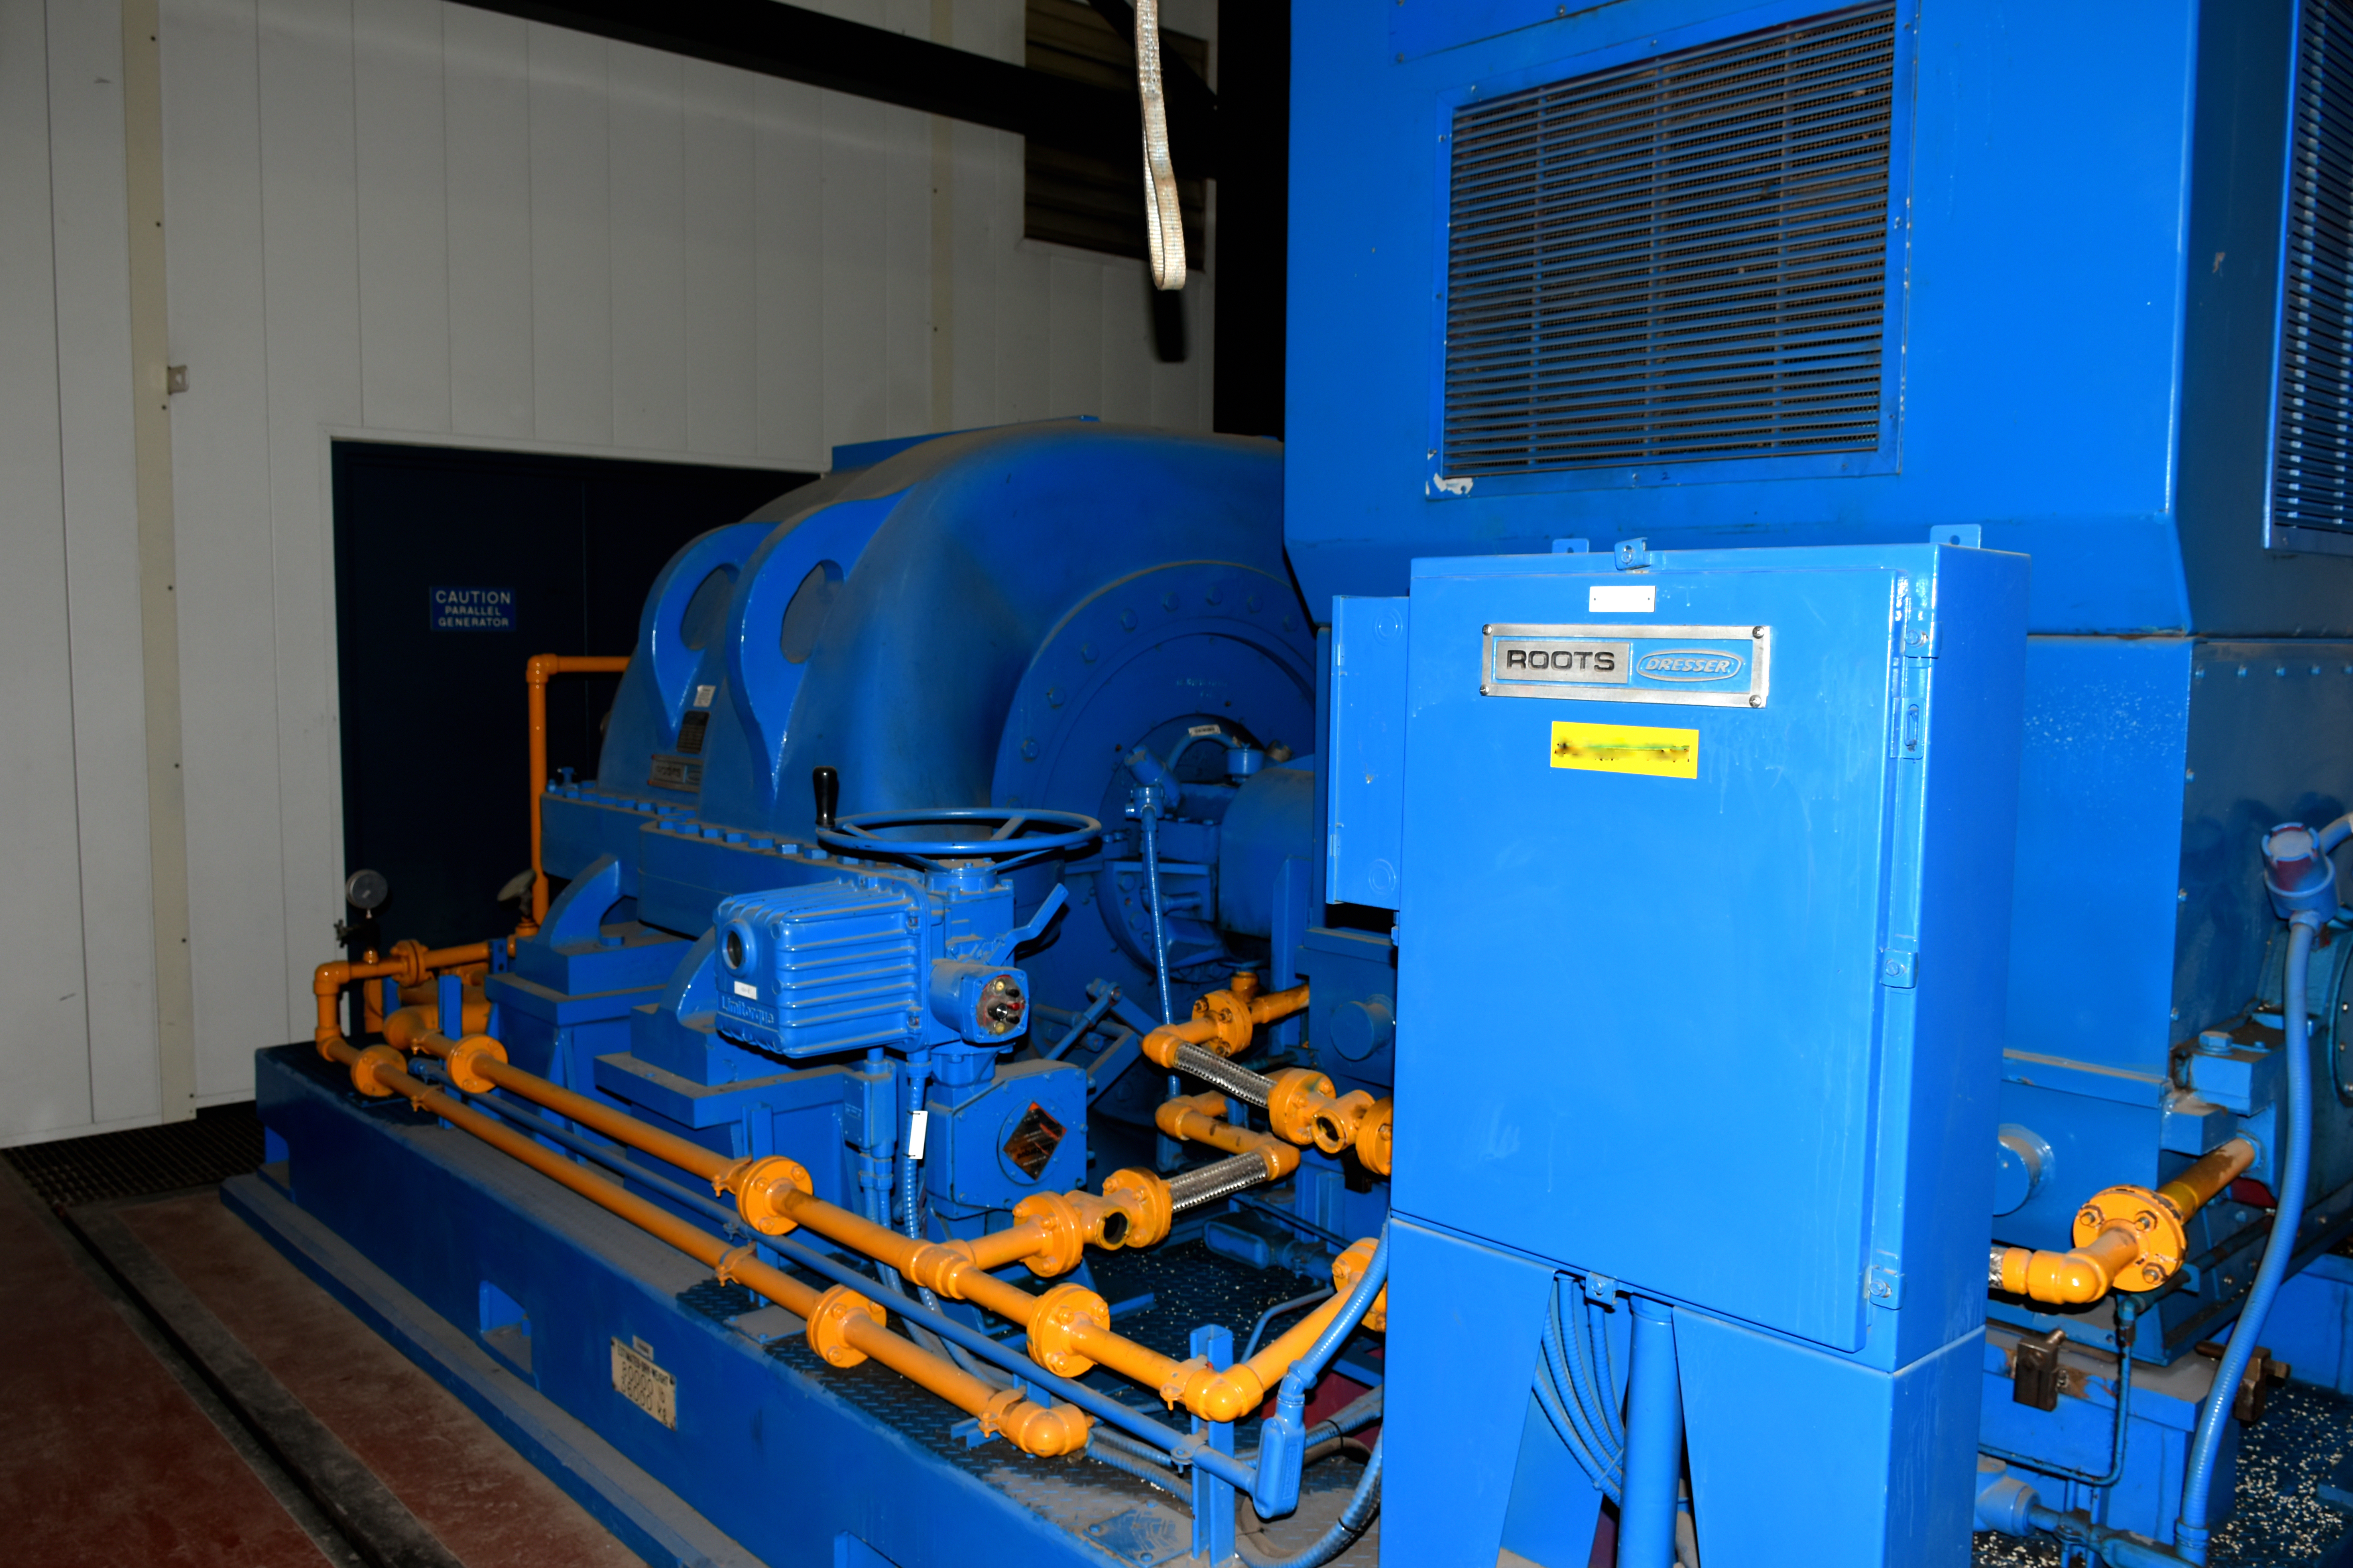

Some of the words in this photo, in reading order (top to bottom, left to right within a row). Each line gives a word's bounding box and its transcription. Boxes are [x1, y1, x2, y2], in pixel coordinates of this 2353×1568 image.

[435, 590, 511, 604] CAUTION
[445, 606, 501, 616] PARALLEL
[438, 617, 509, 628] GENERATOR
[1506, 649, 1615, 672] ROOTS
[1645, 658, 1730, 673] DRESSER
[722, 995, 774, 1025] Limitorque
